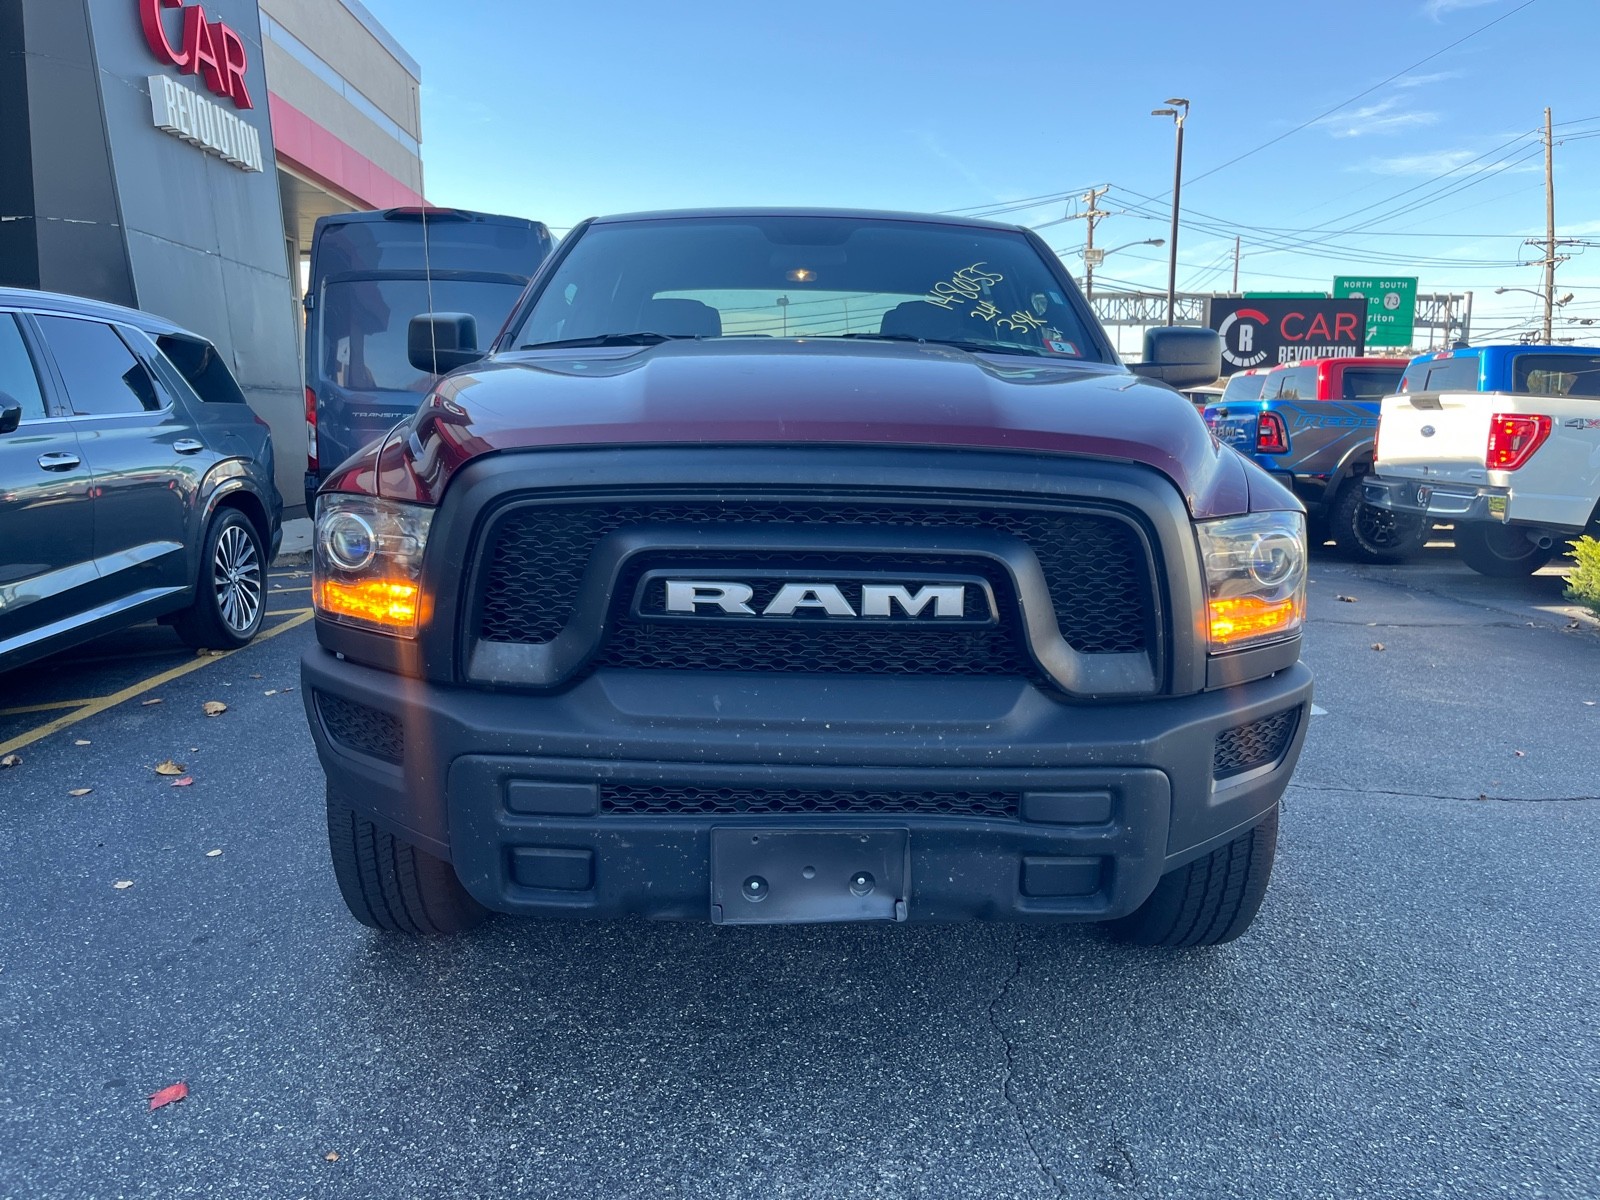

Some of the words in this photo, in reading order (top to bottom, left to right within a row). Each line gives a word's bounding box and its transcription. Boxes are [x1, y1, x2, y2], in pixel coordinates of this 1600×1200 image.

[139, 0, 254, 109] CAR
[147, 74, 264, 174] REVOLUTION
[1343, 281, 1373, 289] NORTH
[1369, 297, 1380, 305] TO
[1386, 296, 1399, 306] 73
[1280, 312, 1358, 341] CAR
[665, 580, 966, 618] RAM
